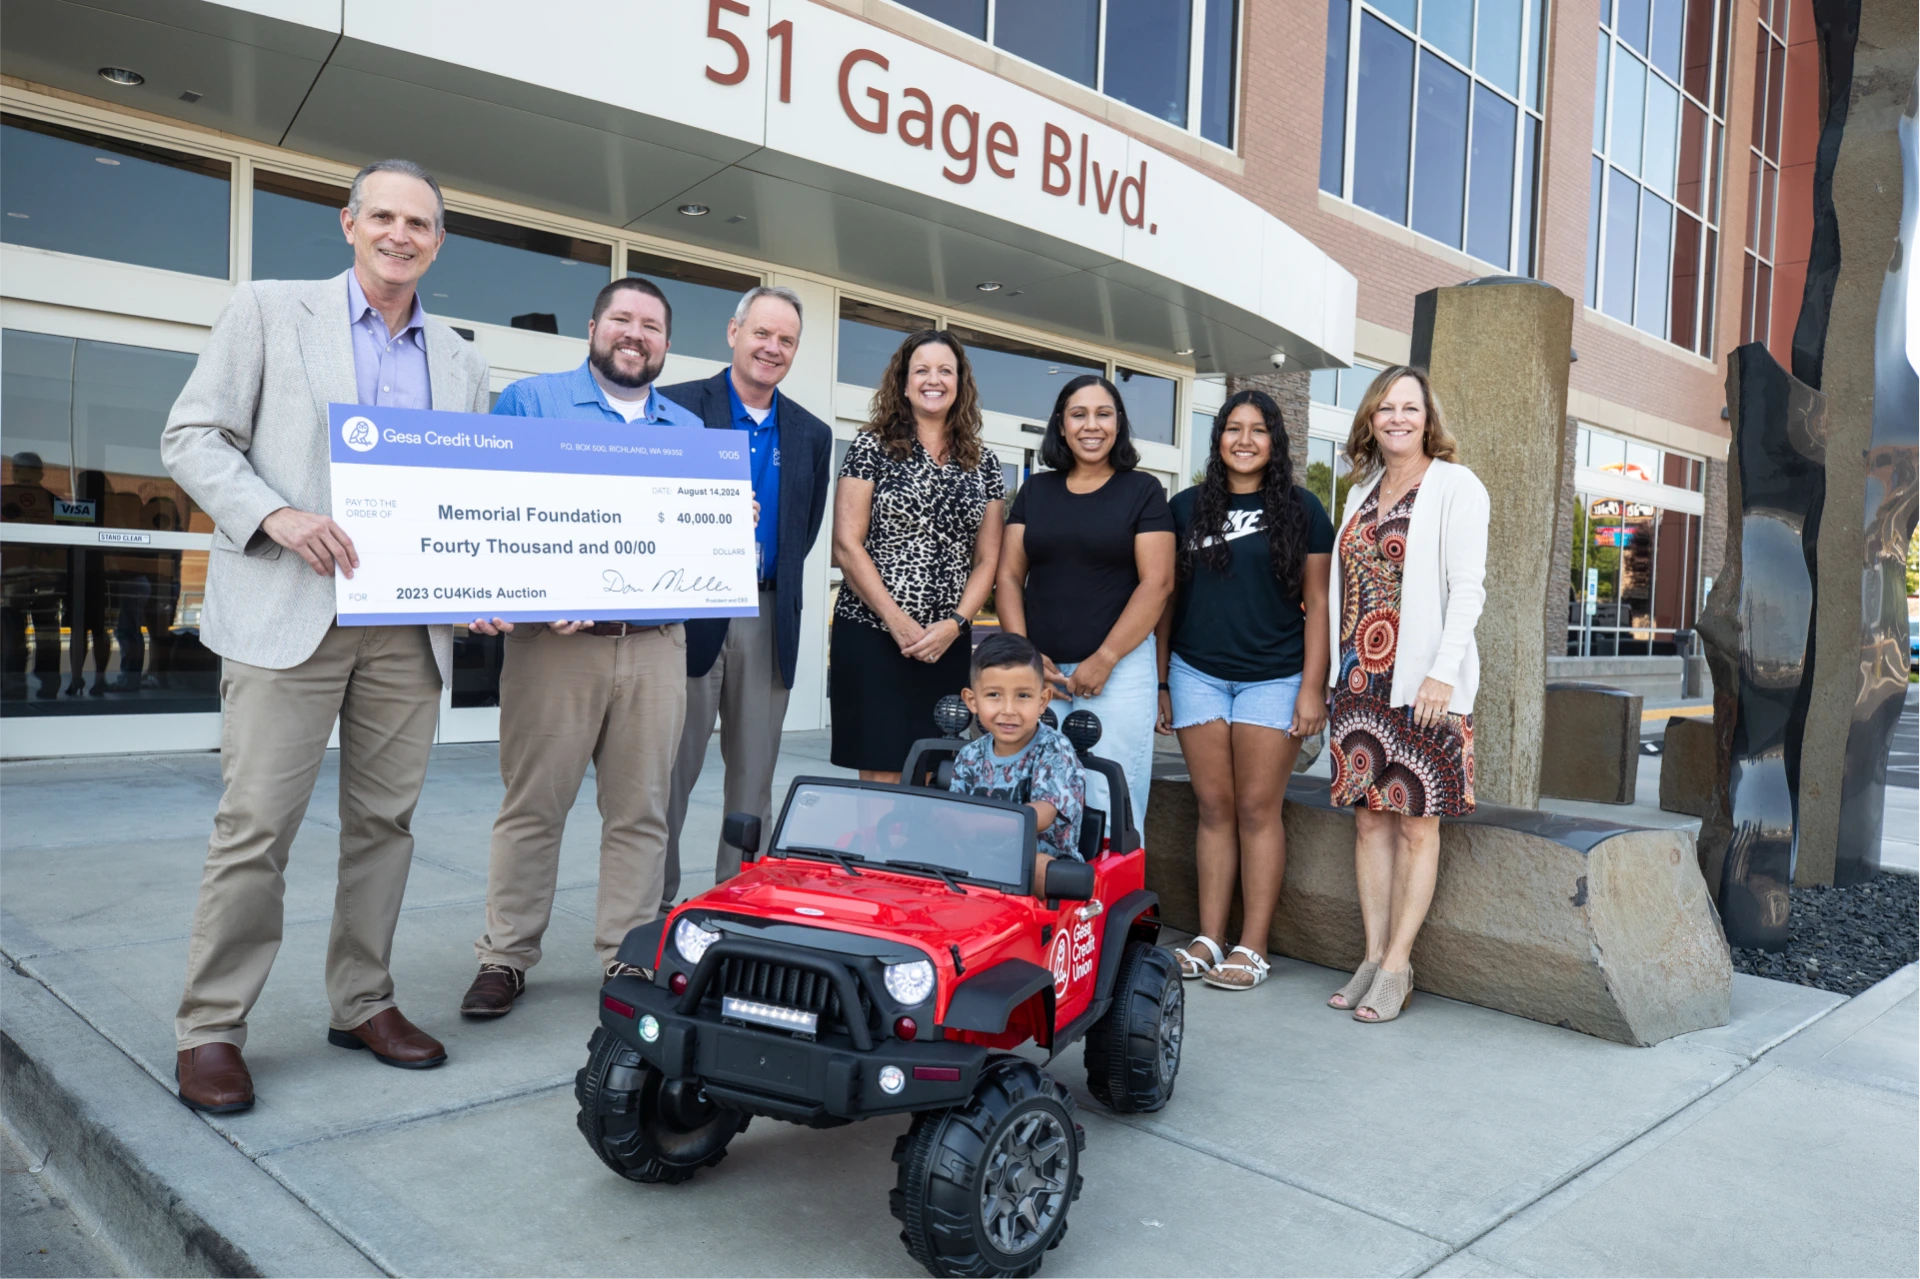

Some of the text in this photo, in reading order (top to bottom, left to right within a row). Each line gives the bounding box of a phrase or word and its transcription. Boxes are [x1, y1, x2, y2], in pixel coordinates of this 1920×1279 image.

[705, 0, 1158, 235] 51 Gage Blvd.
[383, 428, 513, 449] Gesa Credit Union
[592, 445, 607, 453] 500,
[609, 446, 648, 455] RICHLAND,
[662, 448, 683, 456] 99352
[718, 450, 740, 460] 1005
[677, 486, 740, 497] August 14,2024
[61, 504, 90, 515] VISA
[345, 498, 397, 508] PAY TO THE
[346, 509, 392, 519] ORDER OF
[438, 505, 622, 523] Memorial Foundation
[657, 511, 733, 525] $ 40,000.00
[101, 533, 121, 541] STAND
[122, 534, 142, 542] CLEAR
[420, 537, 656, 557] Fourty Thousand and 00/00
[713, 548, 745, 556] DOLLARS
[651, 567, 732, 593] Miller
[348, 593, 368, 602] FOR
[396, 586, 547, 600] 2023 CU4Kids Auction
[1073, 921, 1091, 942] Gesa
[1072, 934, 1095, 962] Credit
[1072, 957, 1092, 982] Union
